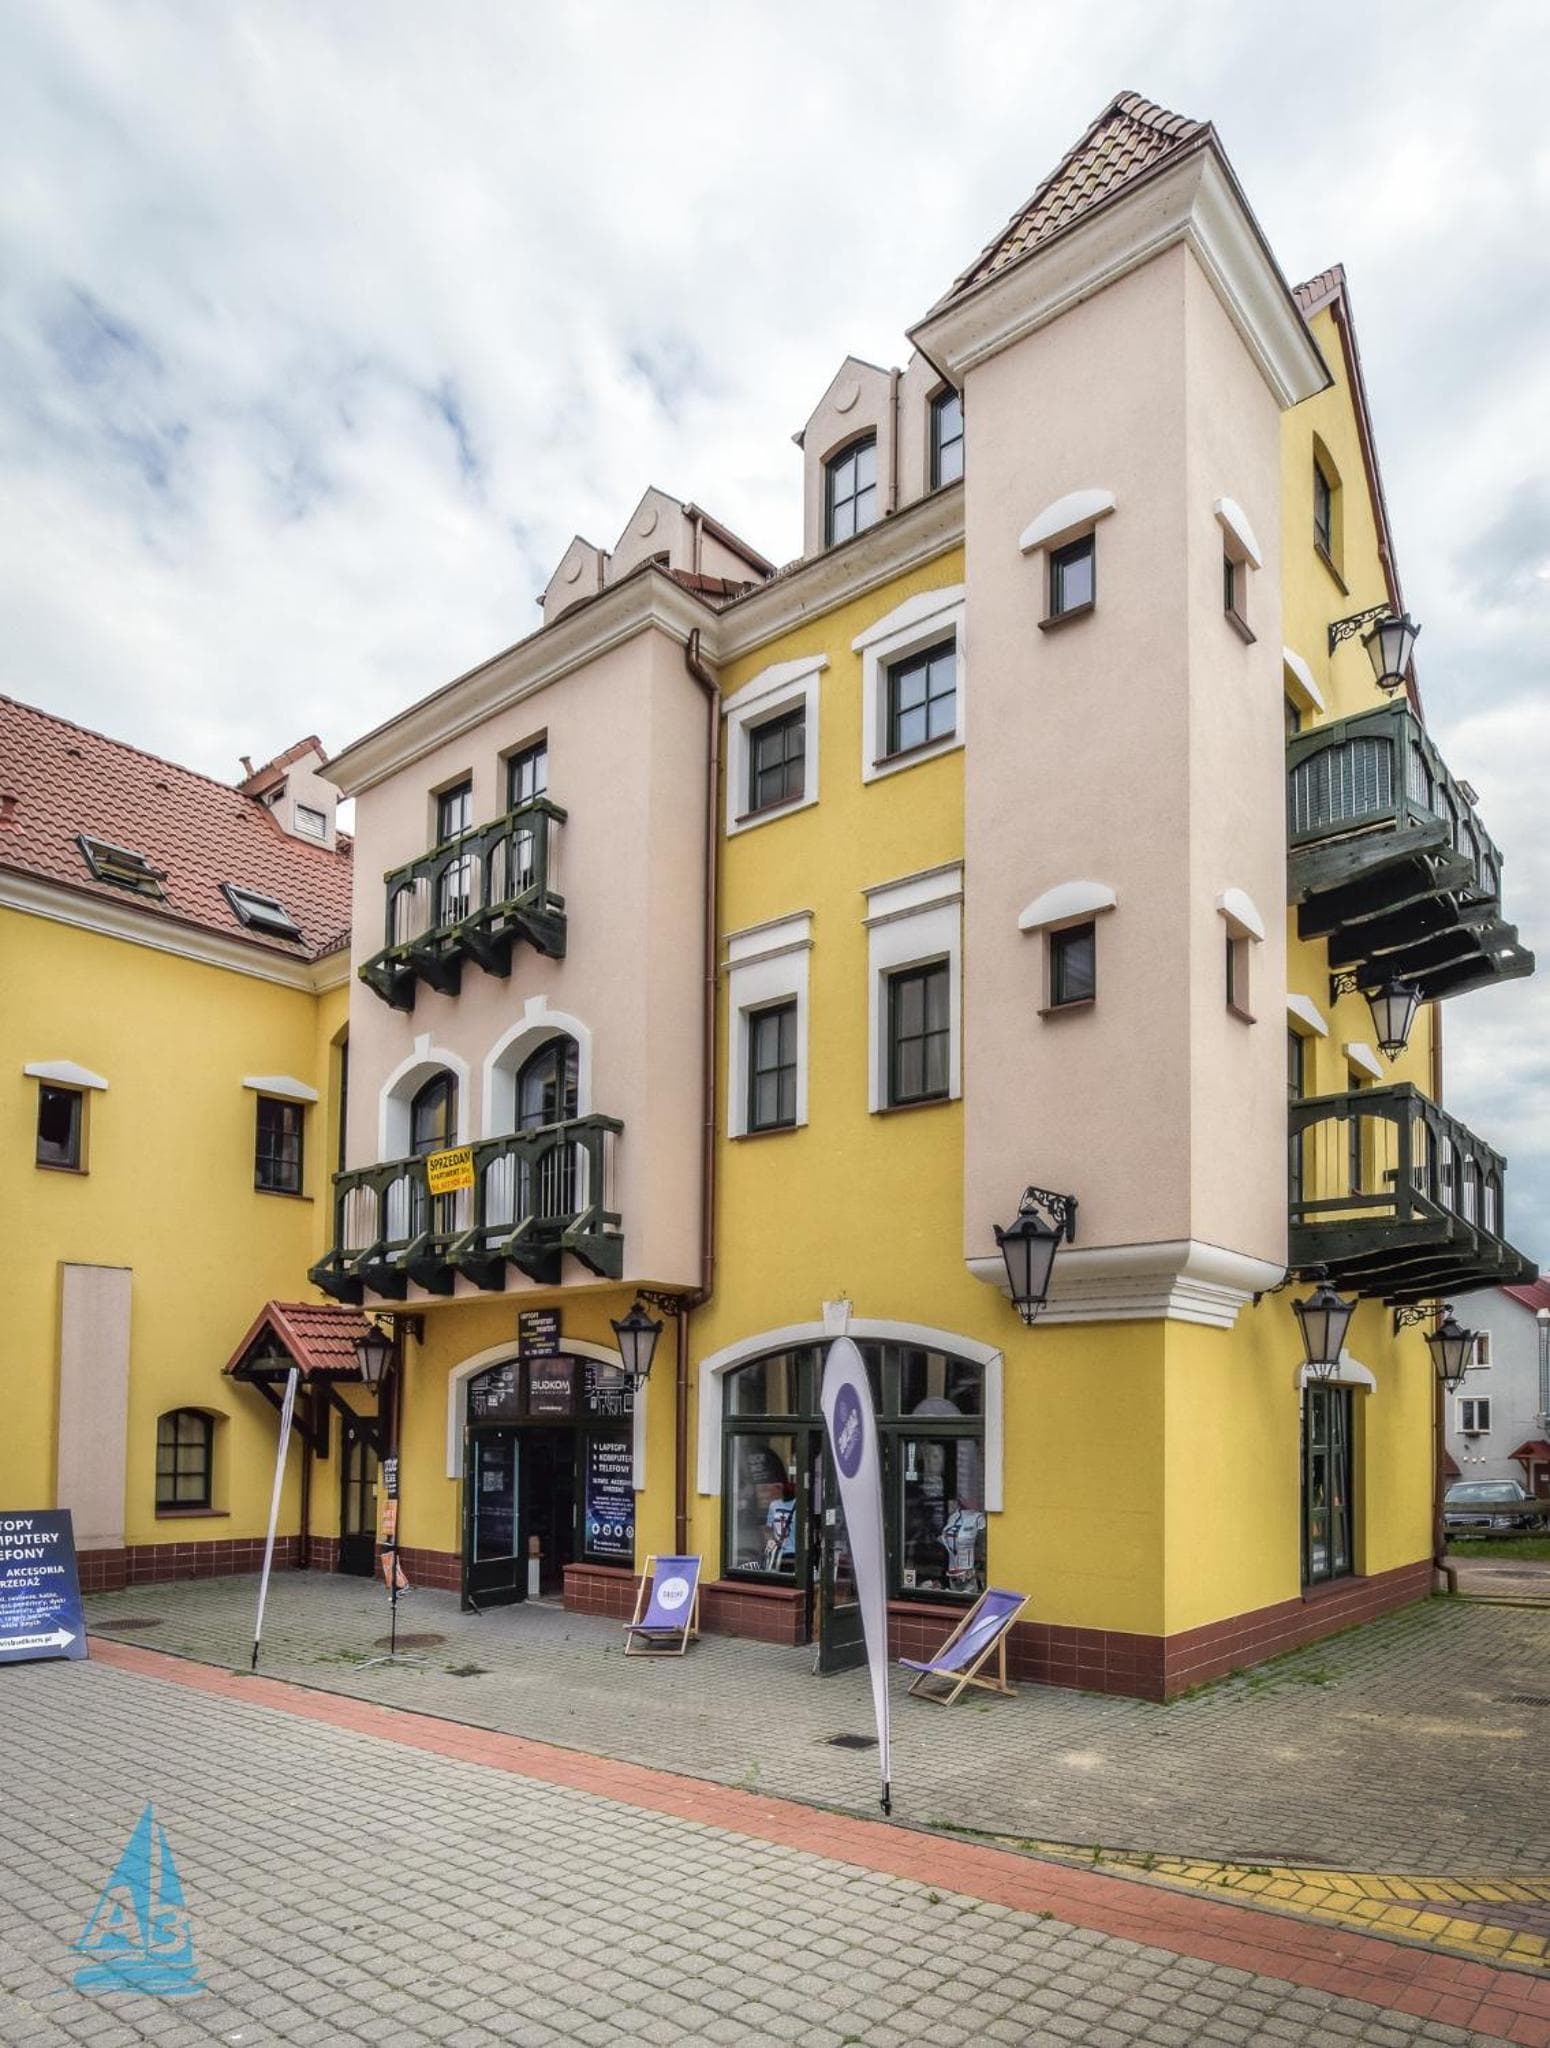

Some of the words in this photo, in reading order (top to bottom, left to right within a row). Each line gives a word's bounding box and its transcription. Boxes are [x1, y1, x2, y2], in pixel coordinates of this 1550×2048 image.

[599, 1443, 627, 1452] LAPTOPY
[599, 1453, 634, 1463] KOMPUTER
[599, 1464, 630, 1472] TELEFONY
[6, 1565, 65, 1577] AKCESORIA
